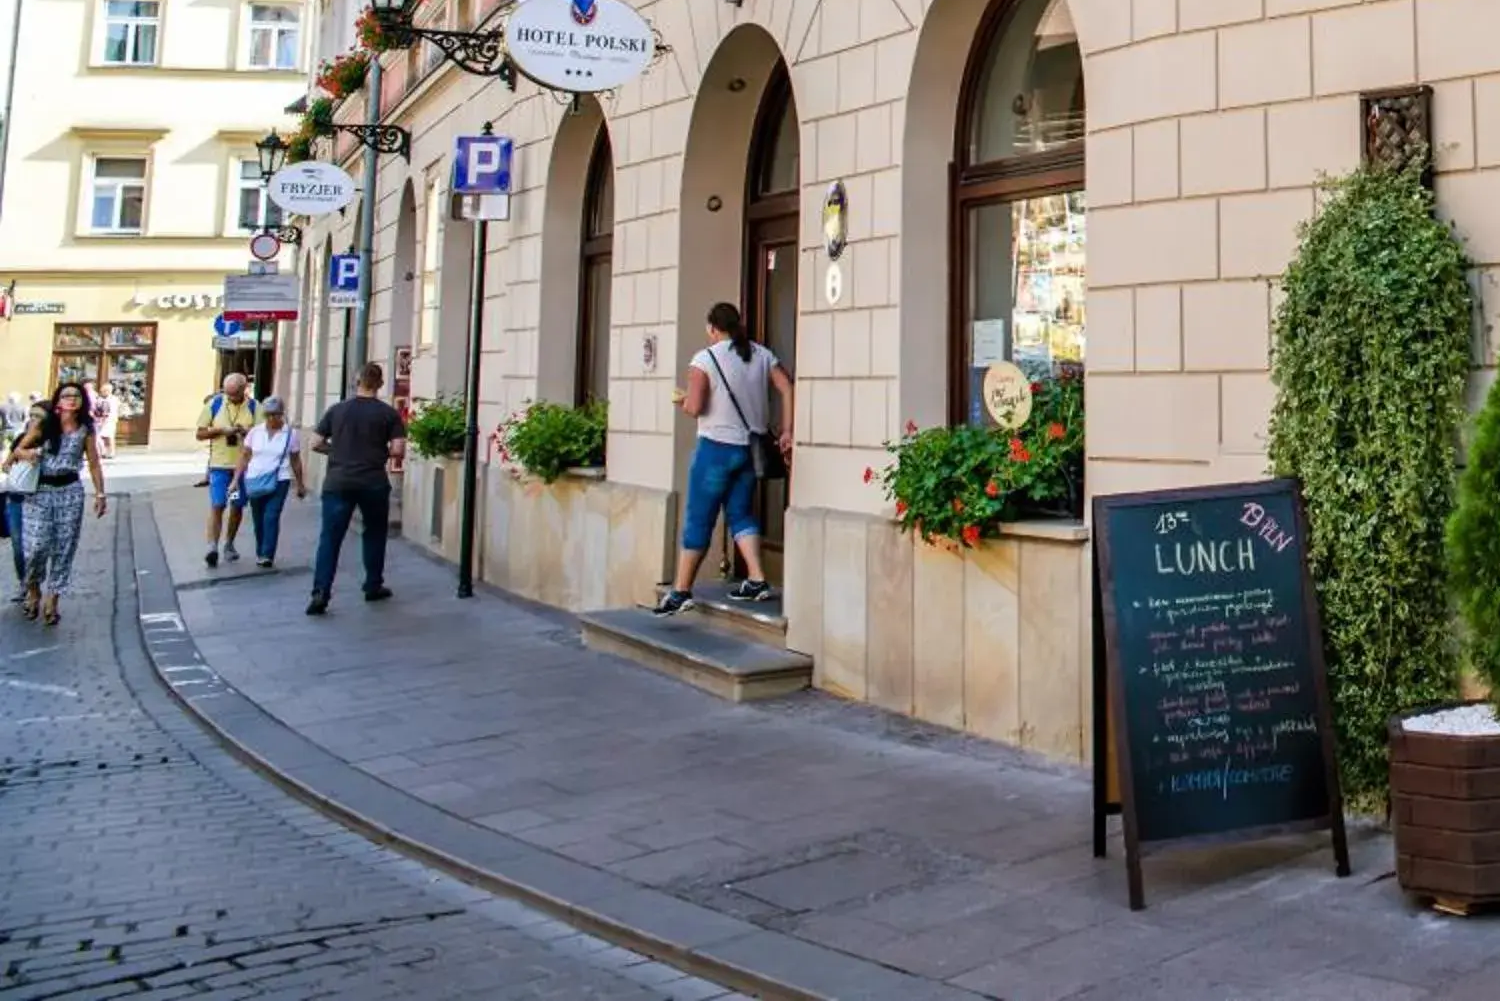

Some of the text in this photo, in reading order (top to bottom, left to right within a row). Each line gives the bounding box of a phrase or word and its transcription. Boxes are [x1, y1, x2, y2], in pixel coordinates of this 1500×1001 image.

[517, 27, 648, 53] HOTEL POLSKI
[467, 142, 501, 185] P
[281, 183, 344, 196] FRYZJER
[338, 257, 359, 286] P
[158, 294, 224, 310] COST
[1259, 516, 1293, 552] PLN
[1154, 537, 1256, 576] LUNCH
